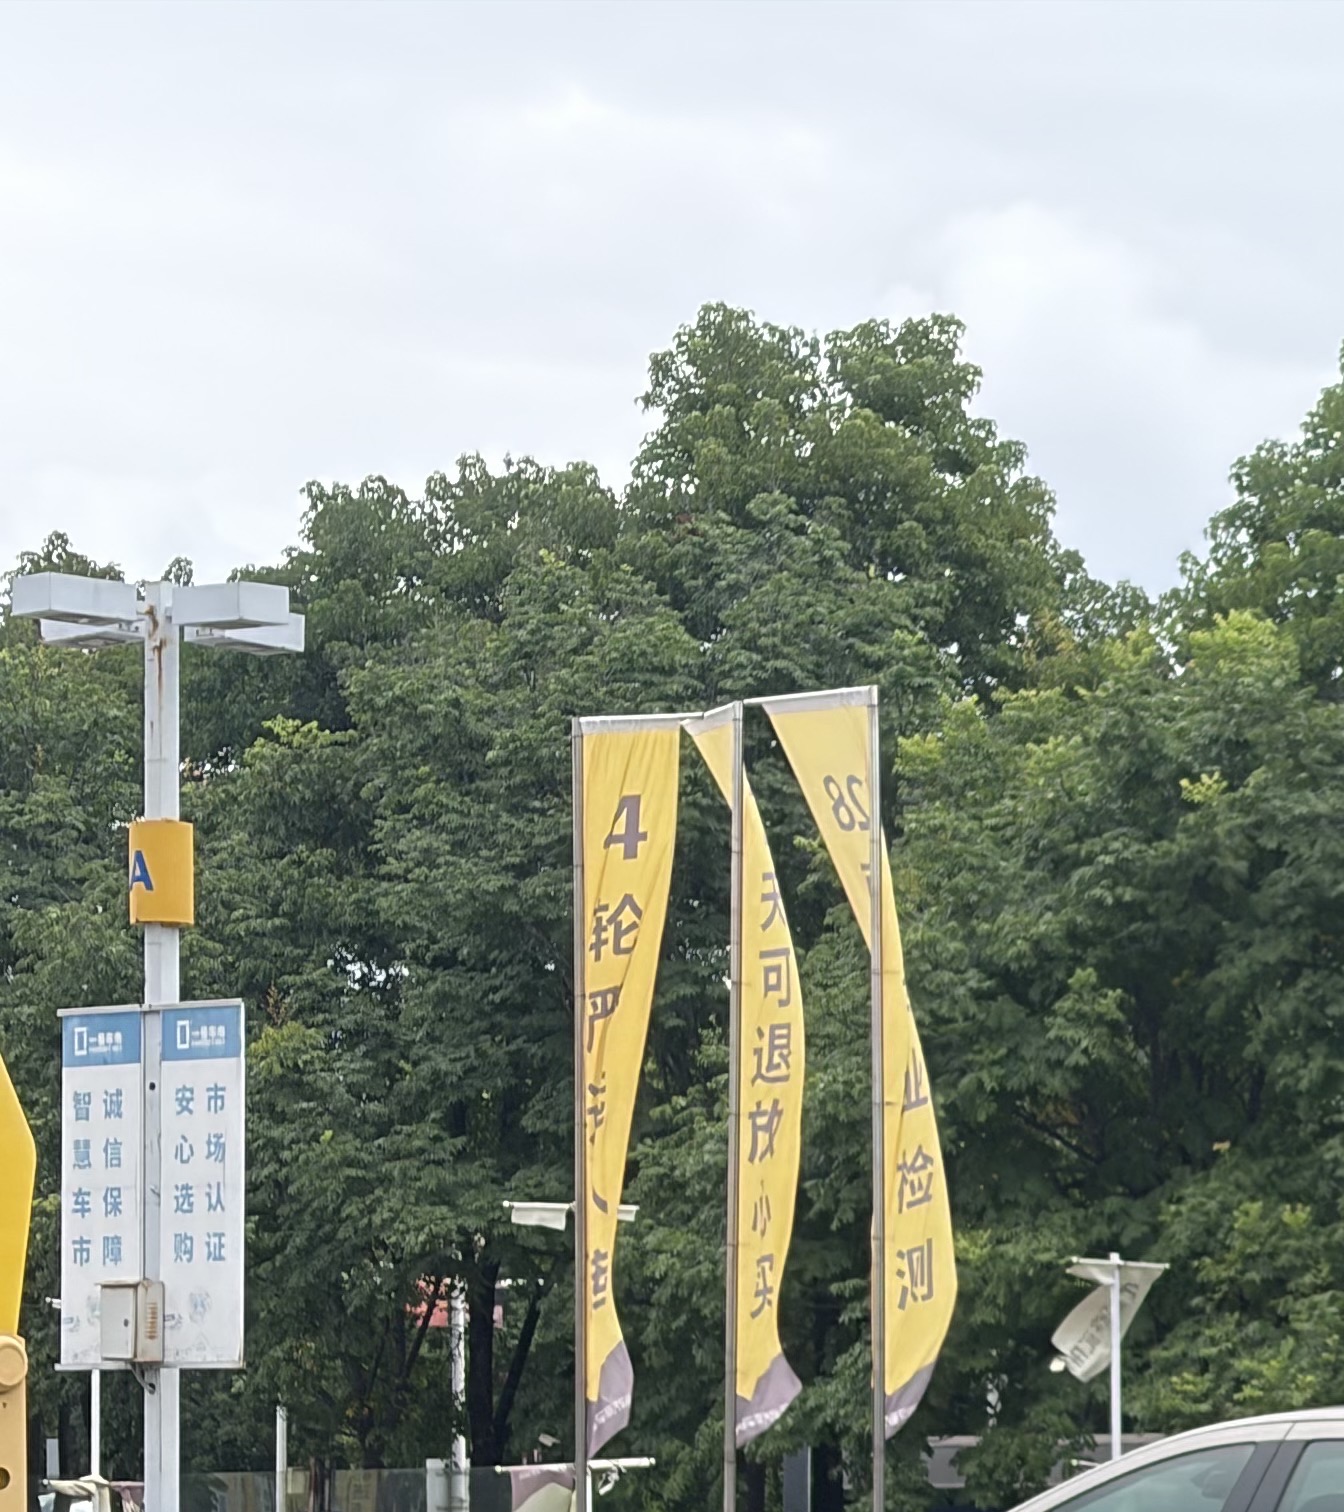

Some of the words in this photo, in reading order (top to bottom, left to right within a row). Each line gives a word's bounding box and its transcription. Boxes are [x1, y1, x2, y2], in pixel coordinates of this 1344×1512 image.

[129, 849, 154, 892] A
[72, 1090, 92, 1267] 智慧车市
[102, 1088, 123, 1267] 诚信保障
[174, 1084, 195, 1264] 安心选购
[205, 1082, 226, 1263] 市场认证
